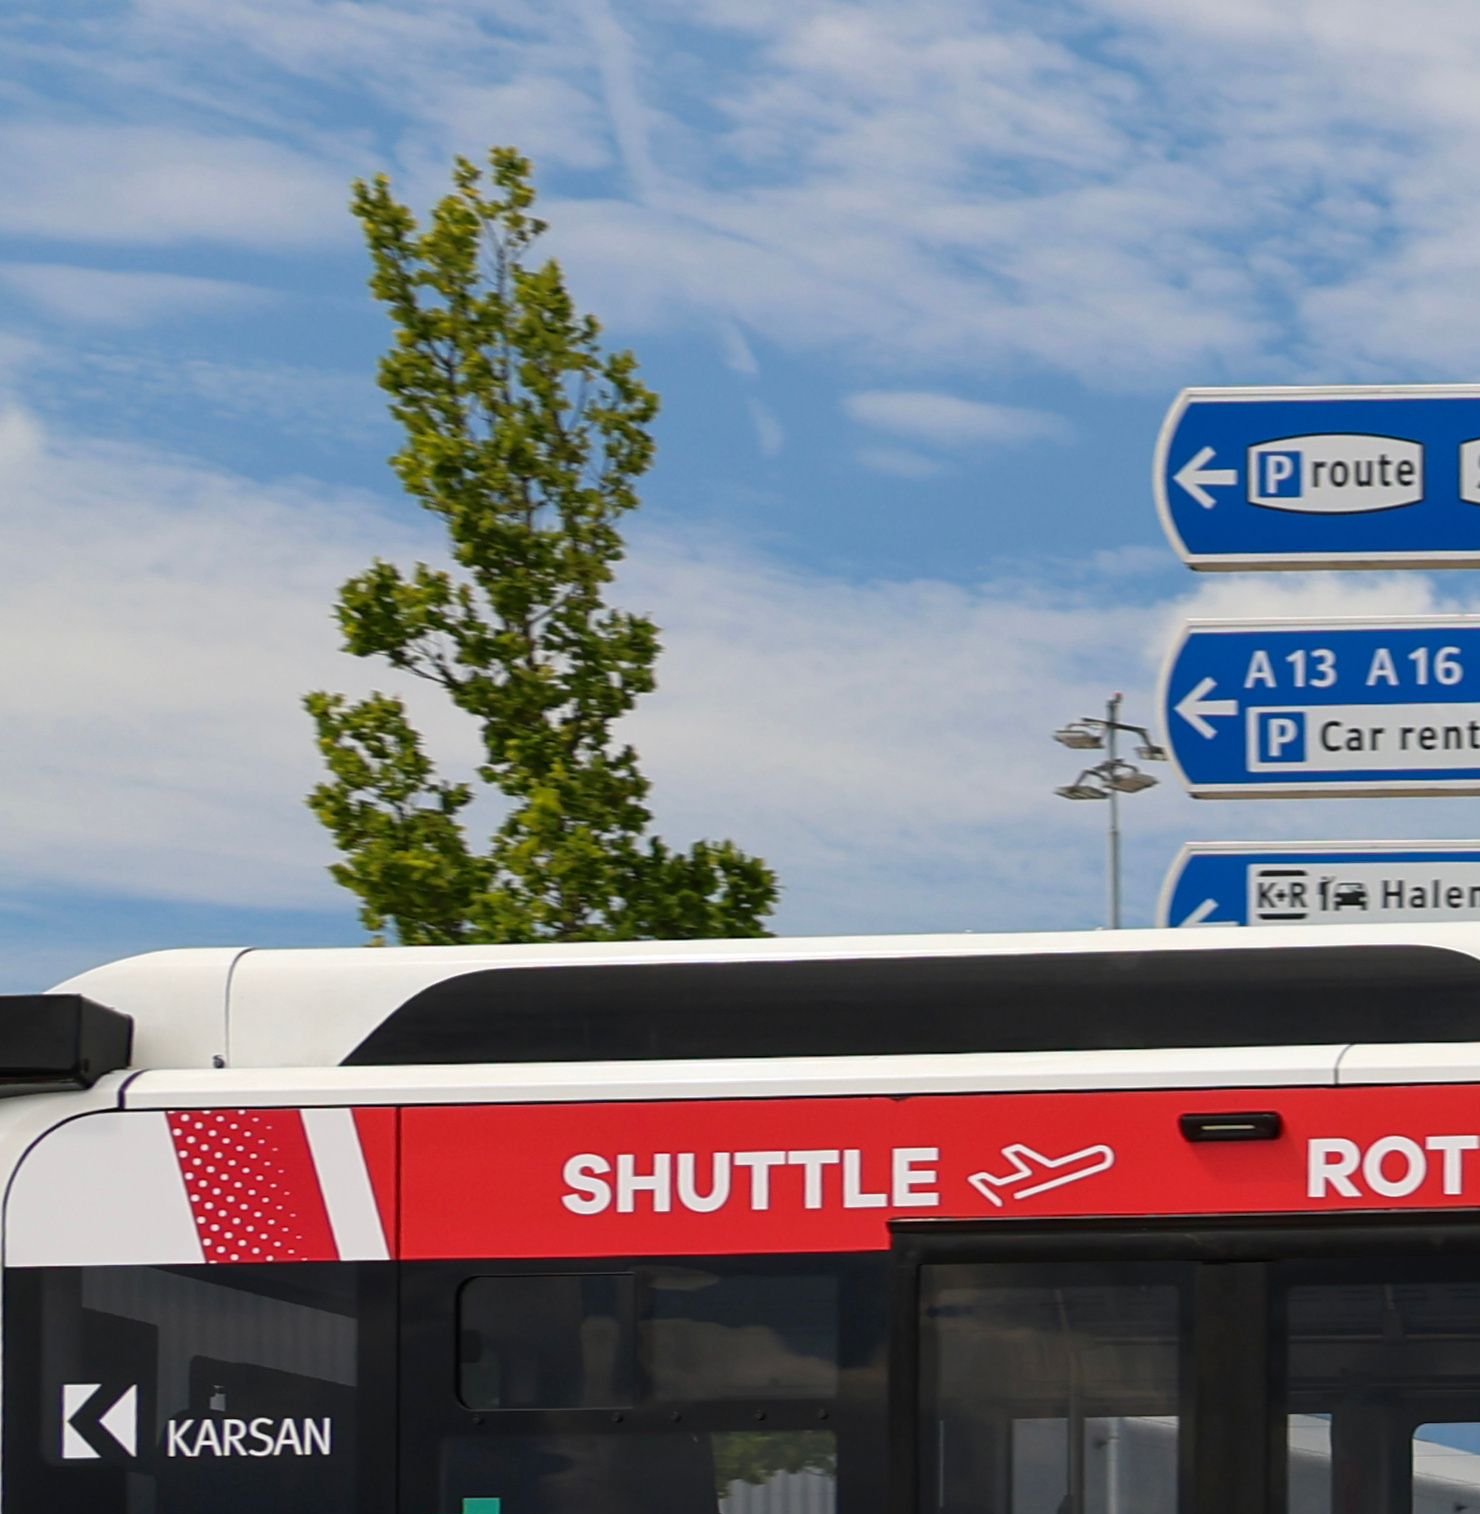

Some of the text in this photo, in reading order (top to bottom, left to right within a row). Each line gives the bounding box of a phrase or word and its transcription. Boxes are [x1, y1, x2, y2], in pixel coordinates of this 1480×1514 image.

[1312, 453, 1415, 489] route
[1320, 719, 1384, 752] Car
[1257, 882, 1308, 908] K+R
[561, 1147, 939, 1215] SHUTTLE
[167, 1417, 332, 1457] KARSAN
